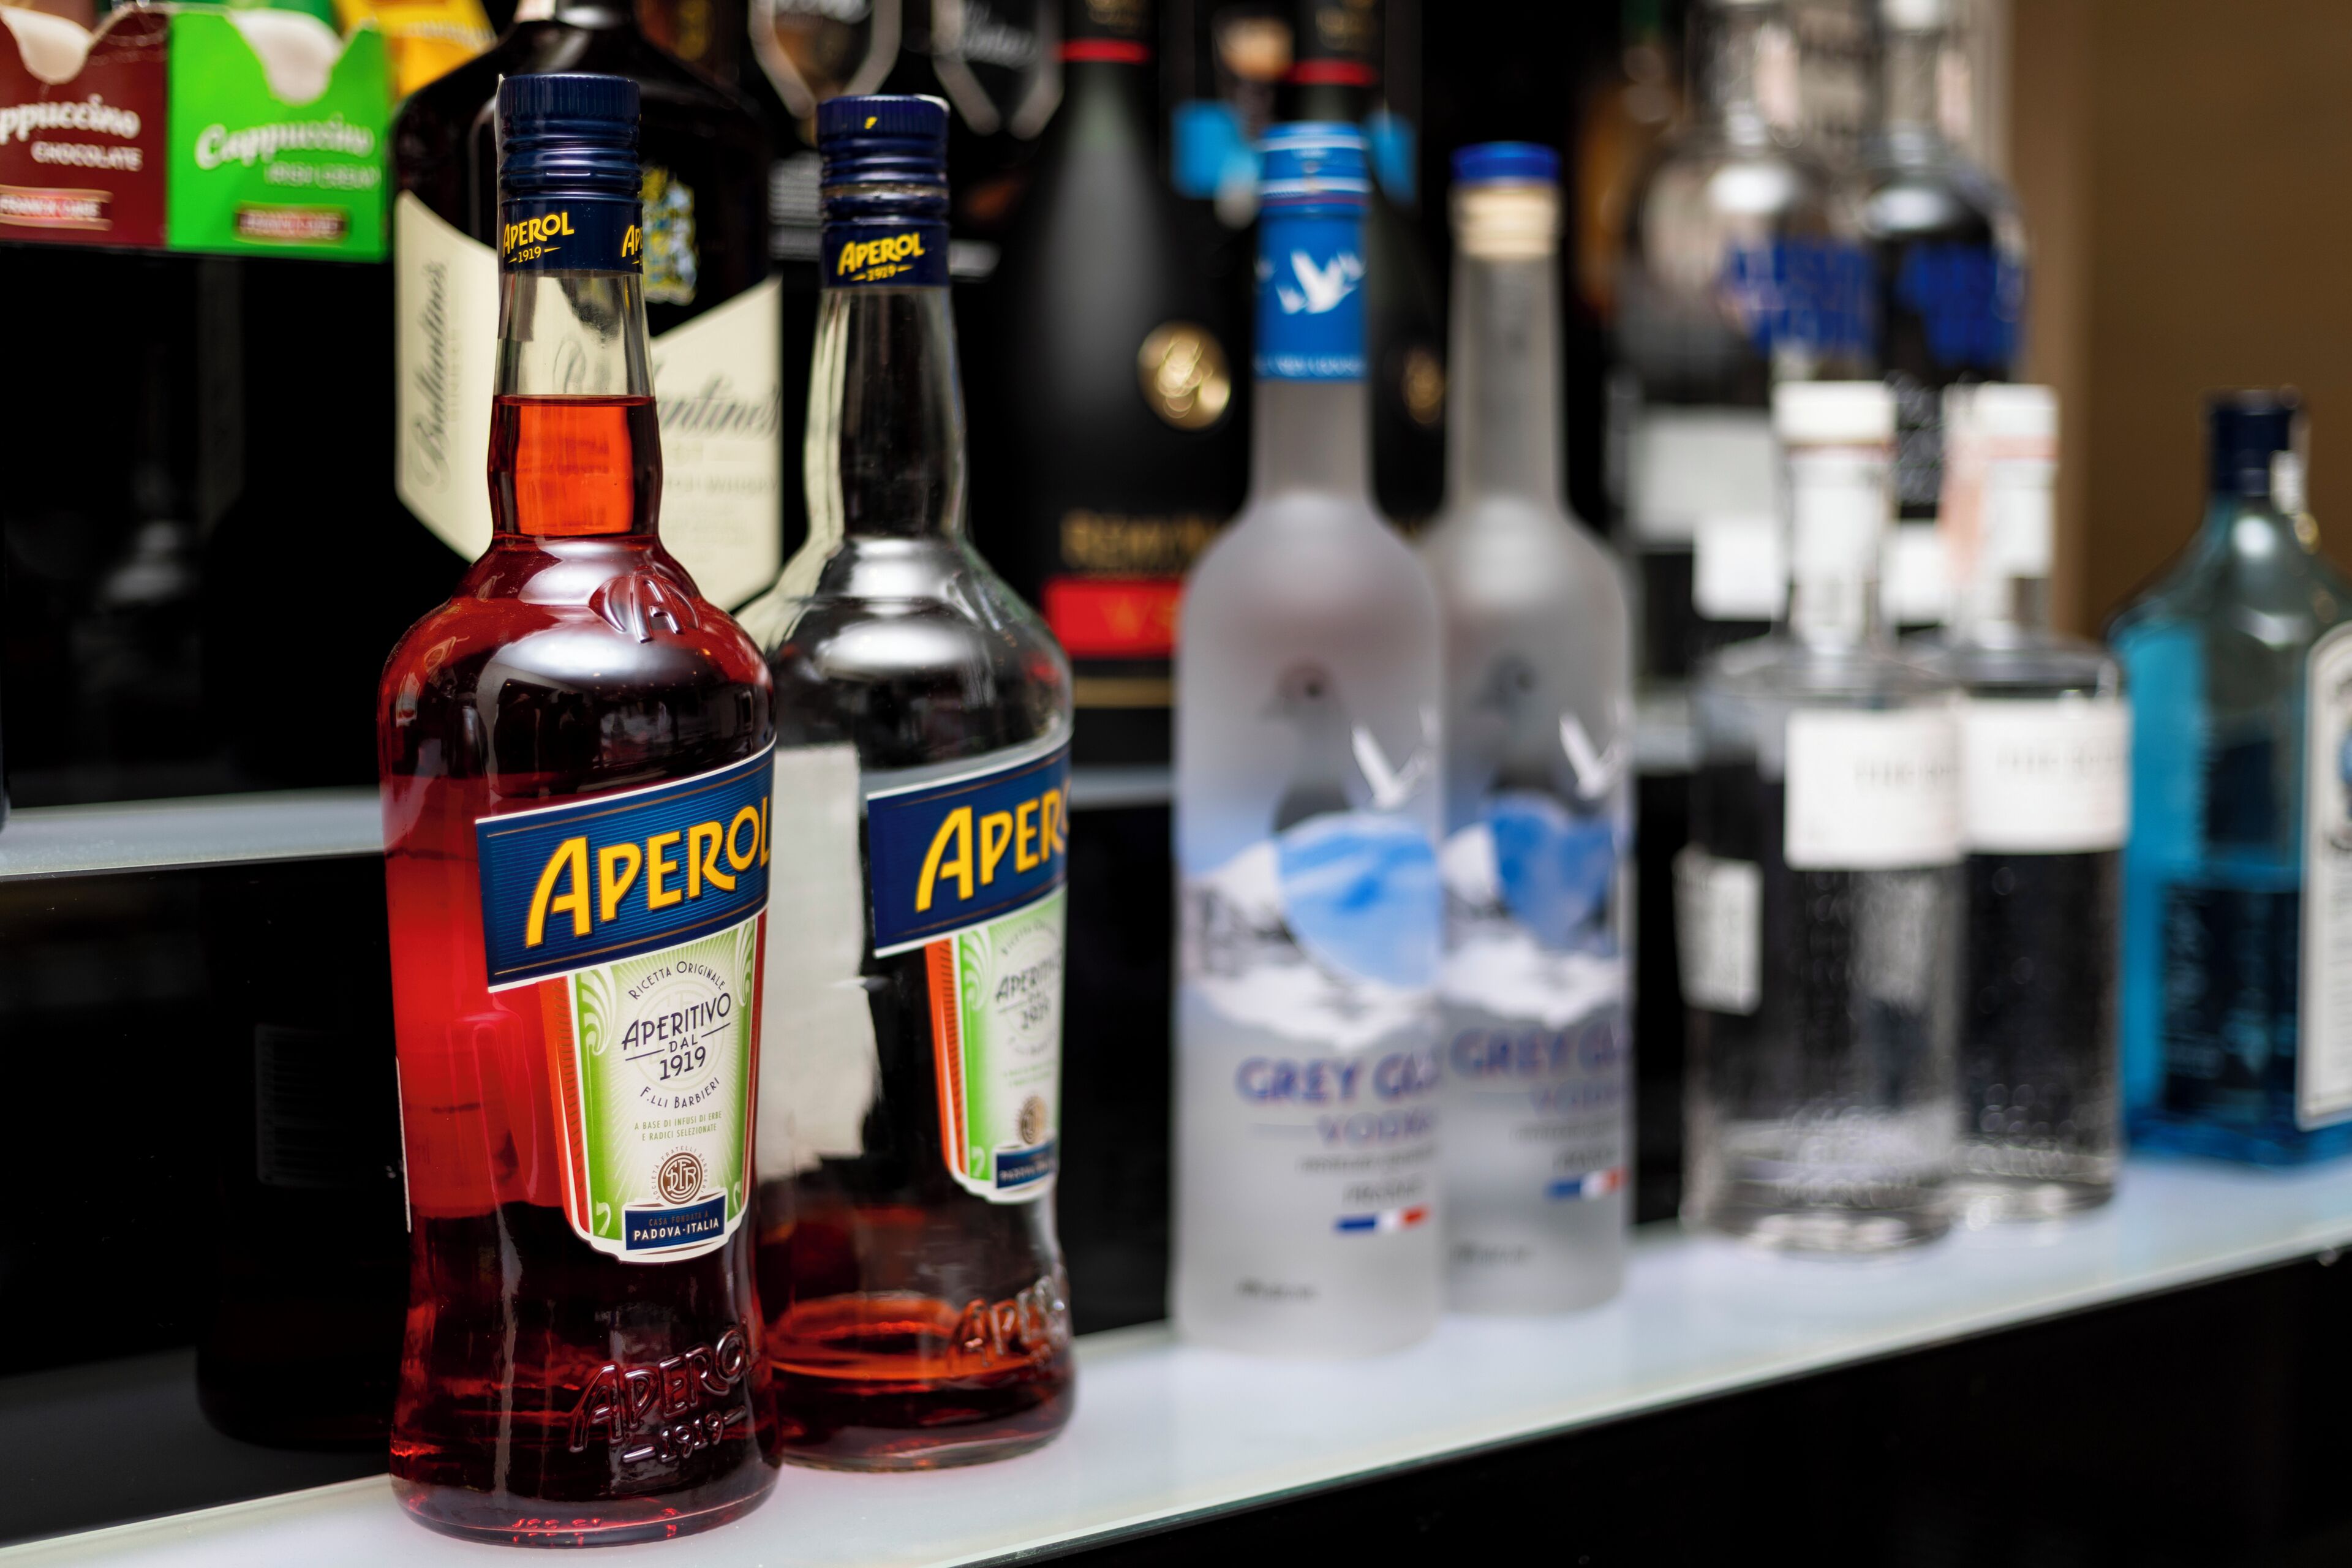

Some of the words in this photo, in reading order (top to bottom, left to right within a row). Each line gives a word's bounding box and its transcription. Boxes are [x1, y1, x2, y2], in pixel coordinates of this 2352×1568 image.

[31, 140, 143, 172] CHOCOLATE
[194, 111, 375, 170] Cappuccino
[503, 212, 575, 257] APEROL
[518, 246, 541, 263] 1919
[837, 232, 925, 276] APEROL
[915, 781, 1069, 913] APER
[526, 796, 771, 949] APEROL
[628, 967, 672, 1000] RICETTA
[676, 961, 725, 990] ORIGINALE
[621, 992, 731, 1050] APERITIVO
[659, 1046, 706, 1081] 1919
[669, 1034, 698, 1053] DAL
[640, 1086, 668, 1108] F.LLI
[674, 1077, 720, 1109] BARBIERI
[1234, 1055, 1365, 1106] GREY
[634, 1122, 639, 1131] A
[643, 1120, 661, 1130] BASE
[664, 1119, 671, 1128] DI
[674, 1116, 697, 1127] INFUSI
[699, 1114, 706, 1123] DI
[708, 1110, 722, 1121] ERBE
[642, 1133, 646, 1141] E
[649, 1130, 674, 1140] RADICI
[677, 1123, 717, 1138] SELEZIONATE
[661, 1145, 698, 1162] FRATELLI
[698, 1153, 709, 1194] BARBIERI
[648, 1218, 668, 1227] CASA
[671, 1214, 702, 1224] FONDATA
[569, 1314, 751, 1452] APERO
[661, 1411, 723, 1463] 1919
